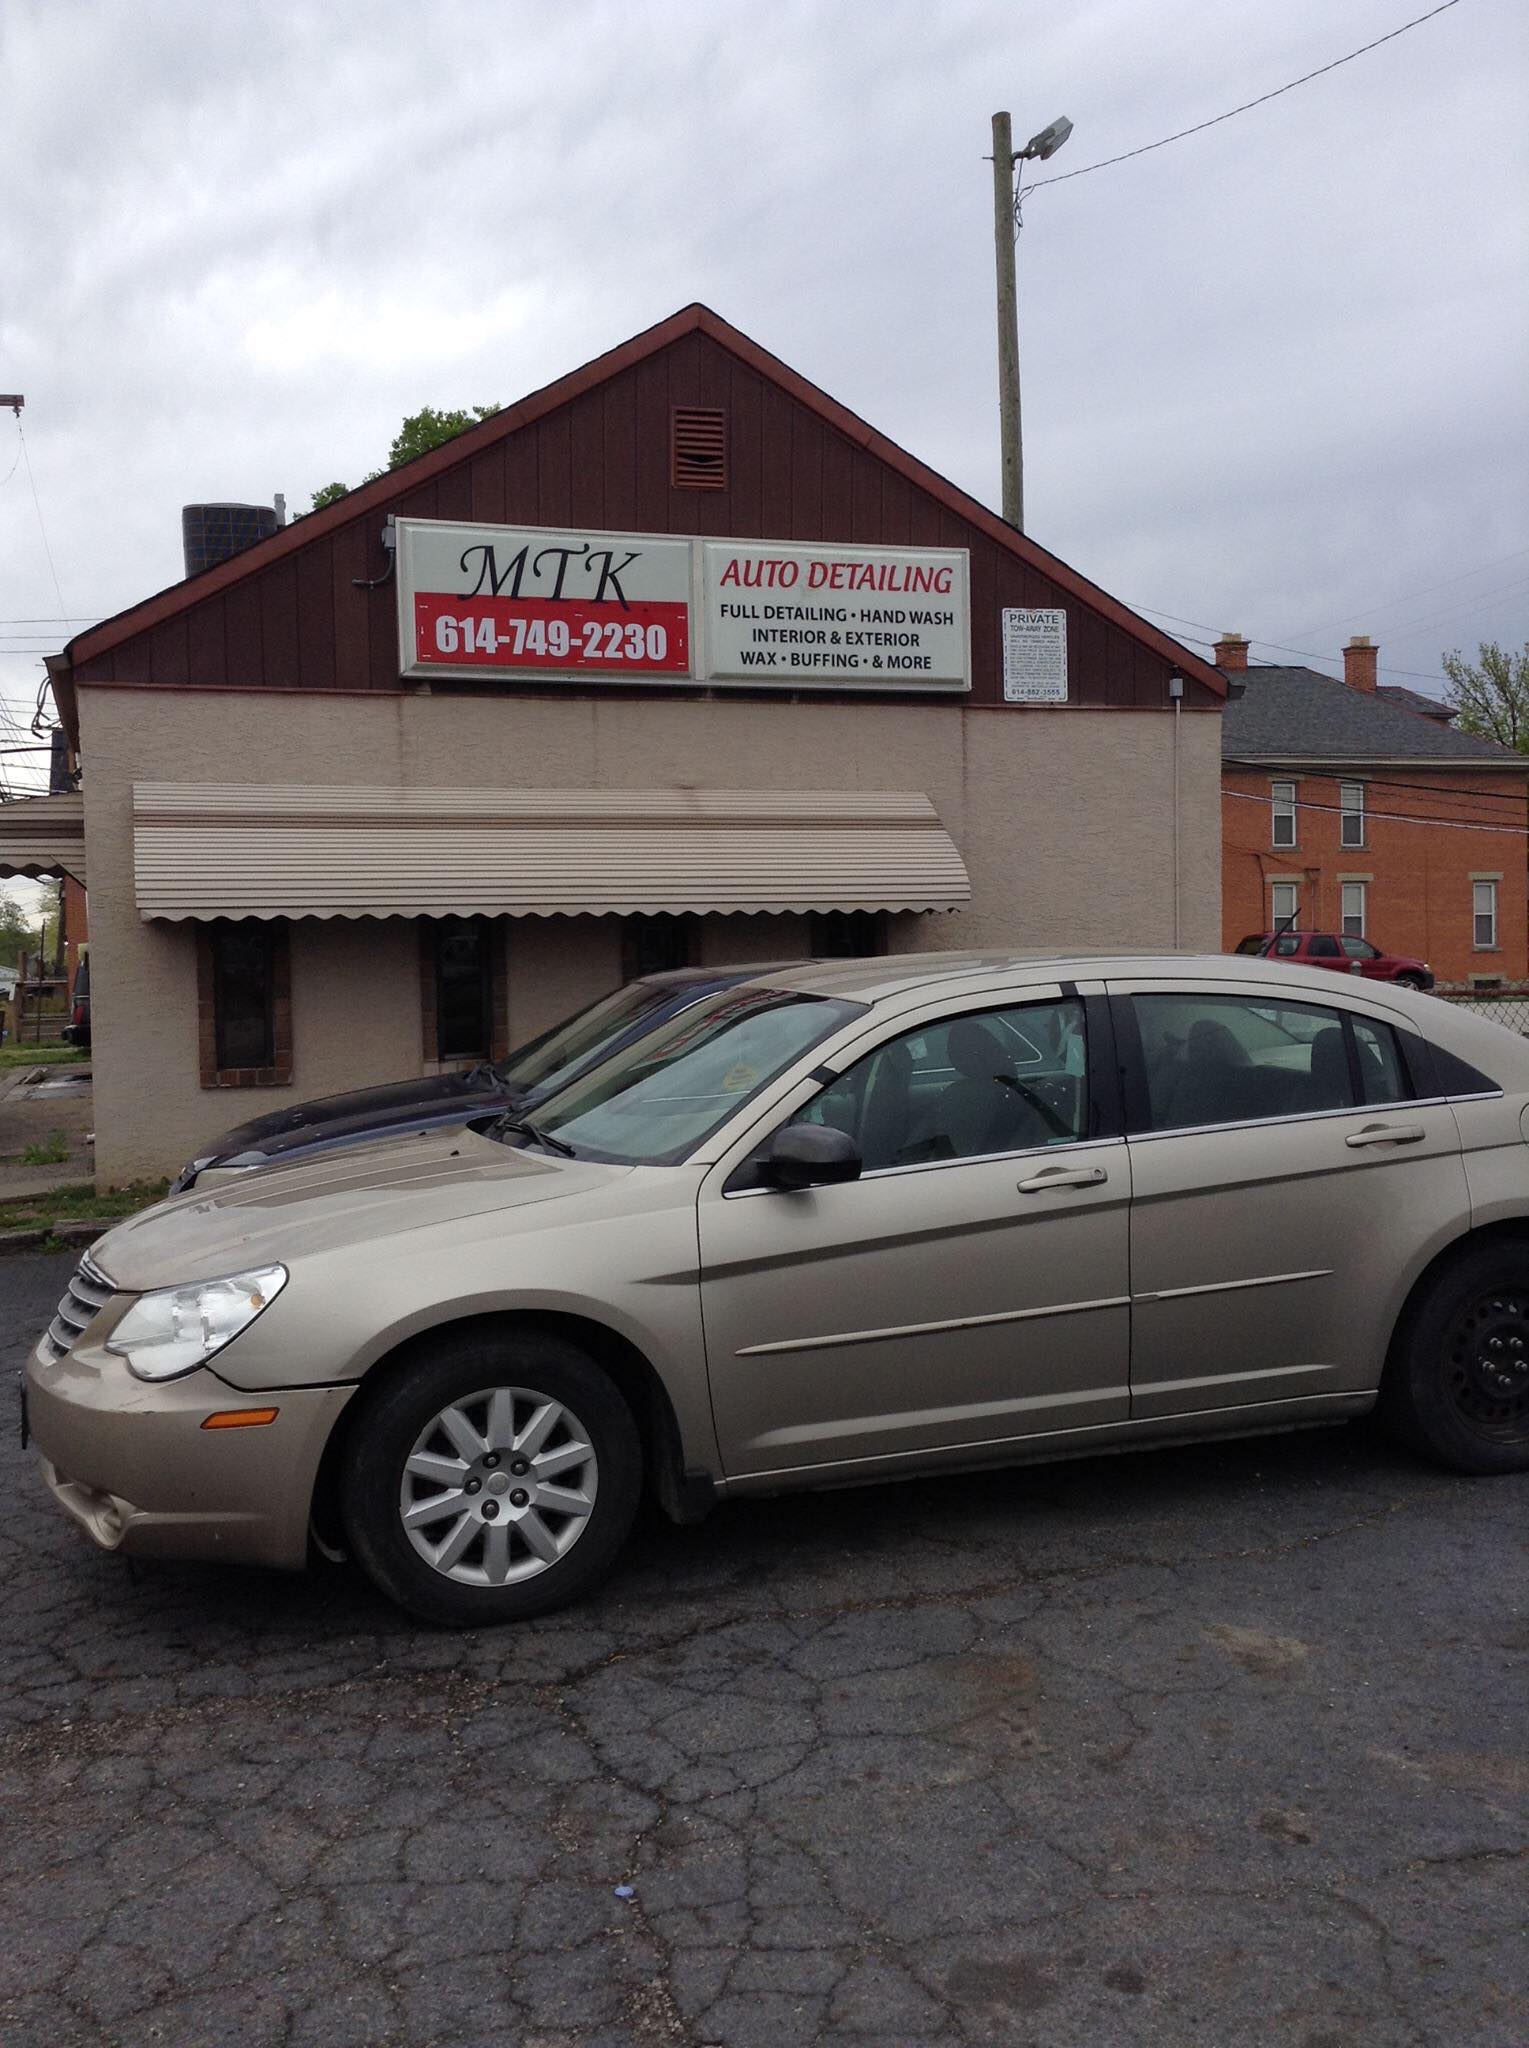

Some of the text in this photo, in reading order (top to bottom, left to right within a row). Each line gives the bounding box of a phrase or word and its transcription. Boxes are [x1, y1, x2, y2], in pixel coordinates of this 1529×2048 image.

[457, 544, 643, 611] MTK
[720, 559, 953, 594] AUTO DETAILING
[720, 604, 954, 626] FULL DETAILING HAND WASH
[1009, 614, 1059, 624] PRIVATE
[435, 615, 667, 661] 614-749-2230
[752, 628, 920, 647] INTERIOR & EXTERIOR
[740, 651, 932, 670] WAX BUFFING & MORE
